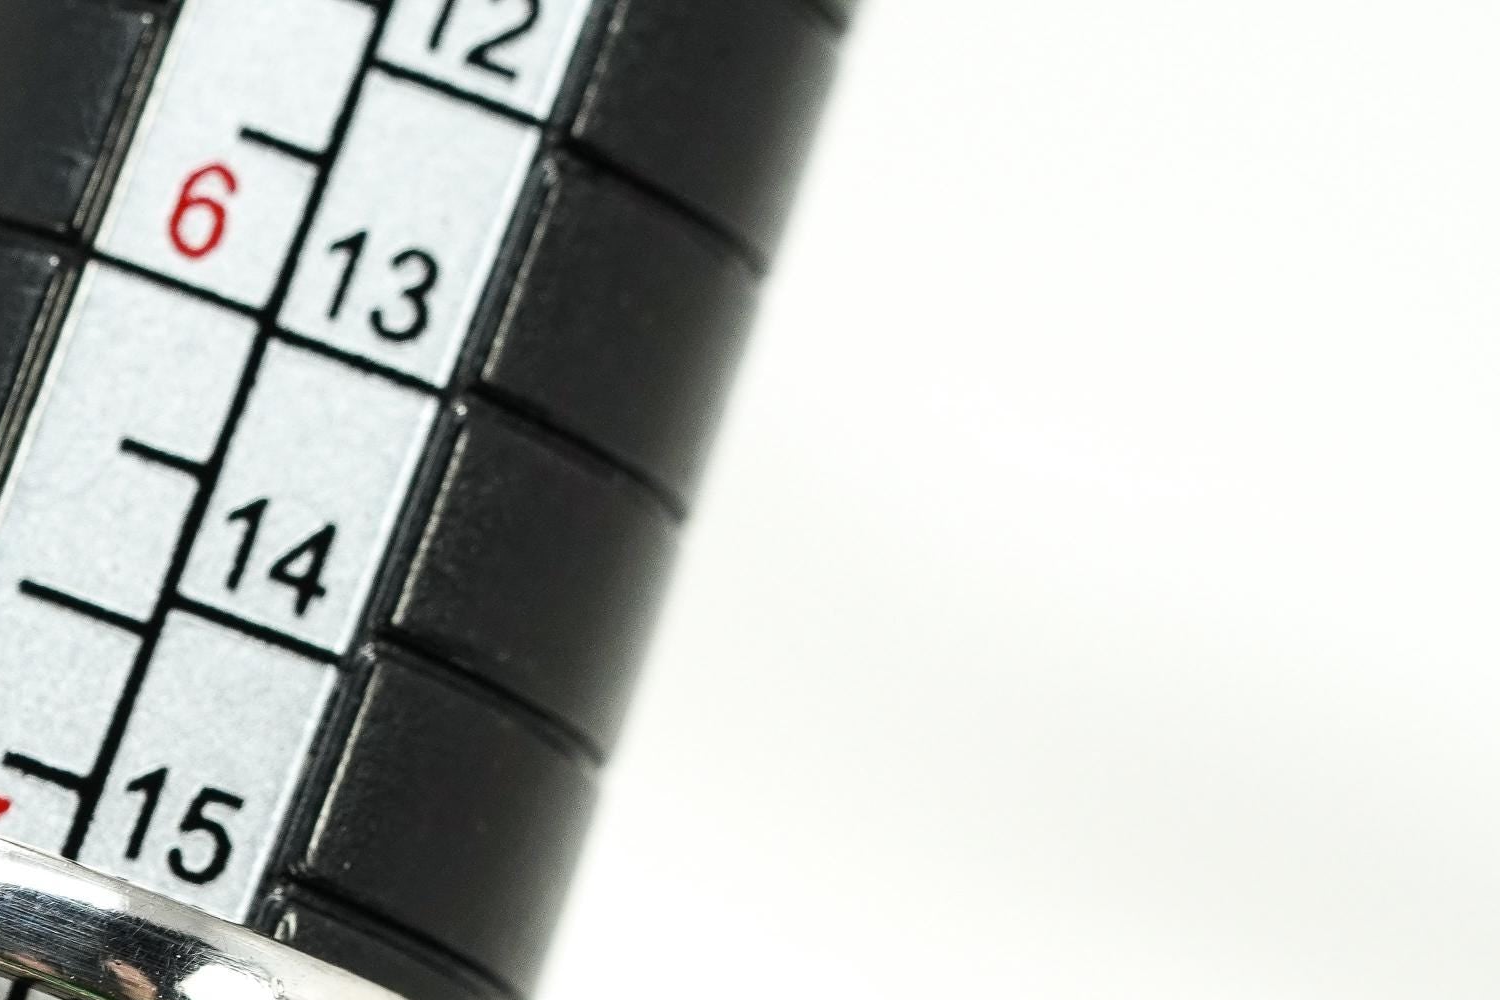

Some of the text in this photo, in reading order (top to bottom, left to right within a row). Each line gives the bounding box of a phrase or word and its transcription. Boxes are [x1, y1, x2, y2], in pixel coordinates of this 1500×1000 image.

[428, 0, 541, 81] 12
[167, 161, 239, 262] 6
[328, 230, 439, 344] 13
[225, 497, 338, 618] 14
[124, 766, 246, 887] 15
